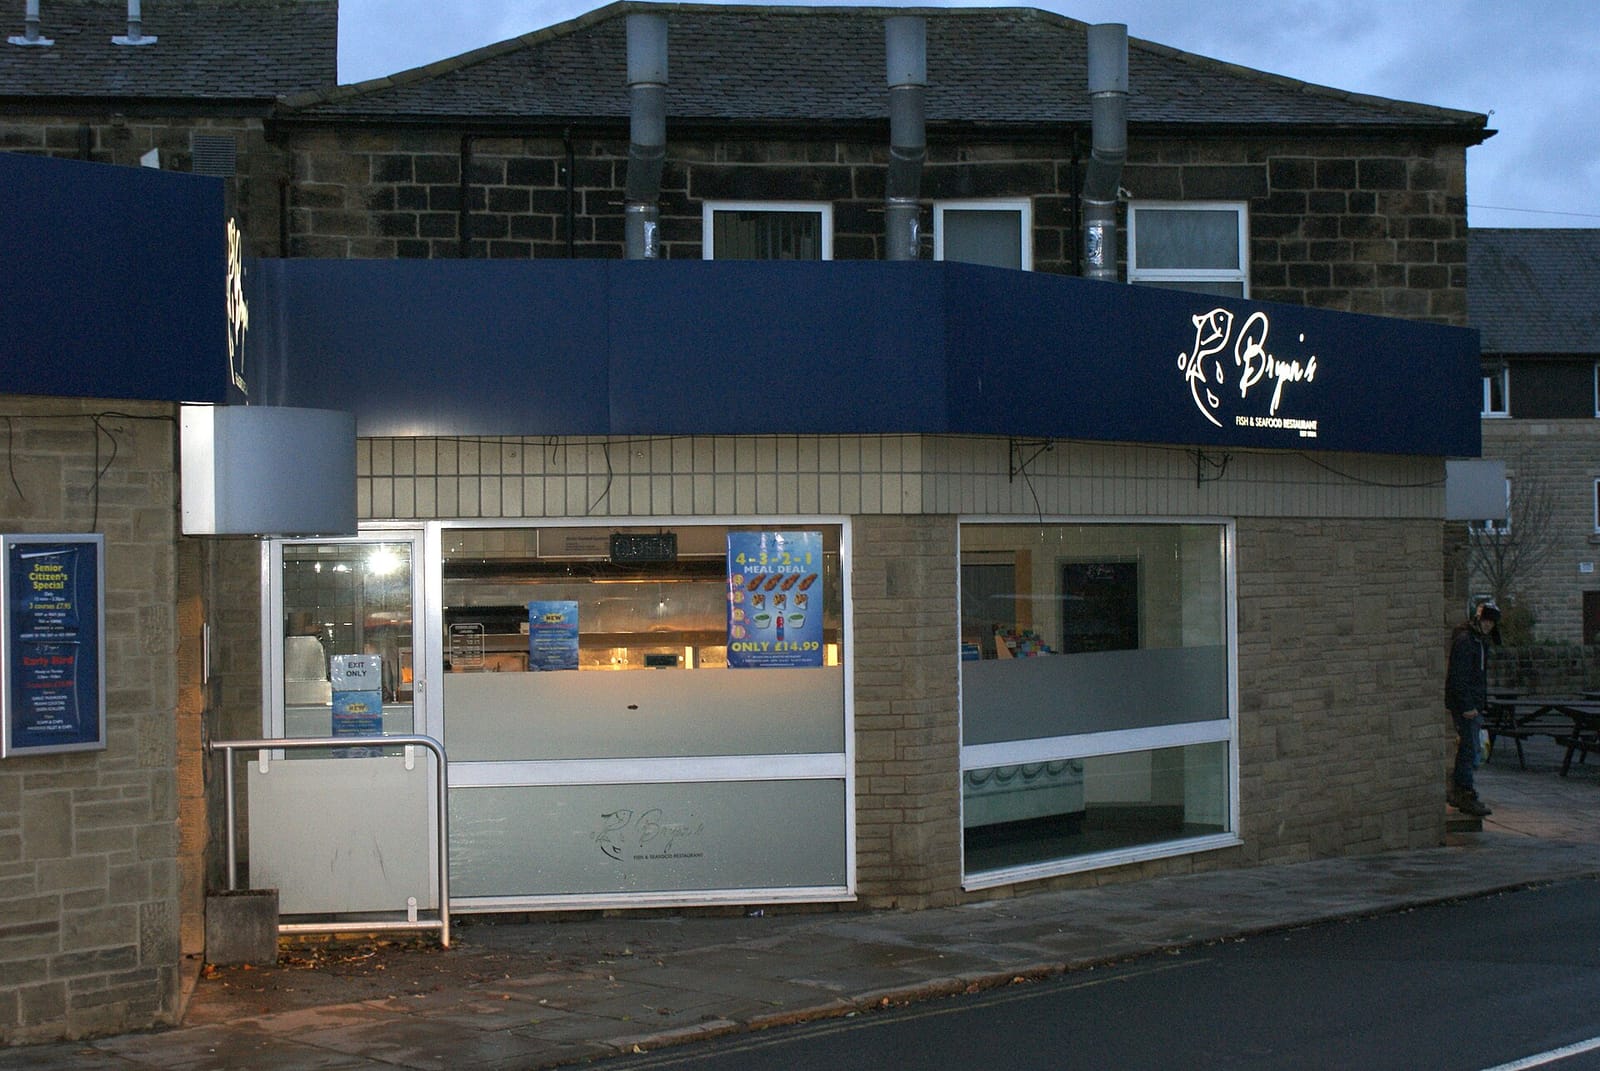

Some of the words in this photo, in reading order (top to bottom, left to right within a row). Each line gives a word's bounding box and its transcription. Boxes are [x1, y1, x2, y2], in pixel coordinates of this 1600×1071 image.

[1235, 416, 1249, 426] FISH
[1249, 417, 1255, 427] &
[1255, 417, 1283, 428] SEAFOOD
[1283, 418, 1318, 430] RESTAURANT
[34, 563, 64, 572] Senior
[744, 565, 774, 574] MEAL
[777, 565, 807, 573] DEAL
[29, 572, 68, 581] Citizen's
[33, 581, 64, 591] Special
[731, 642, 770, 652] ONLY
[774, 641, 819, 652] £14.99
